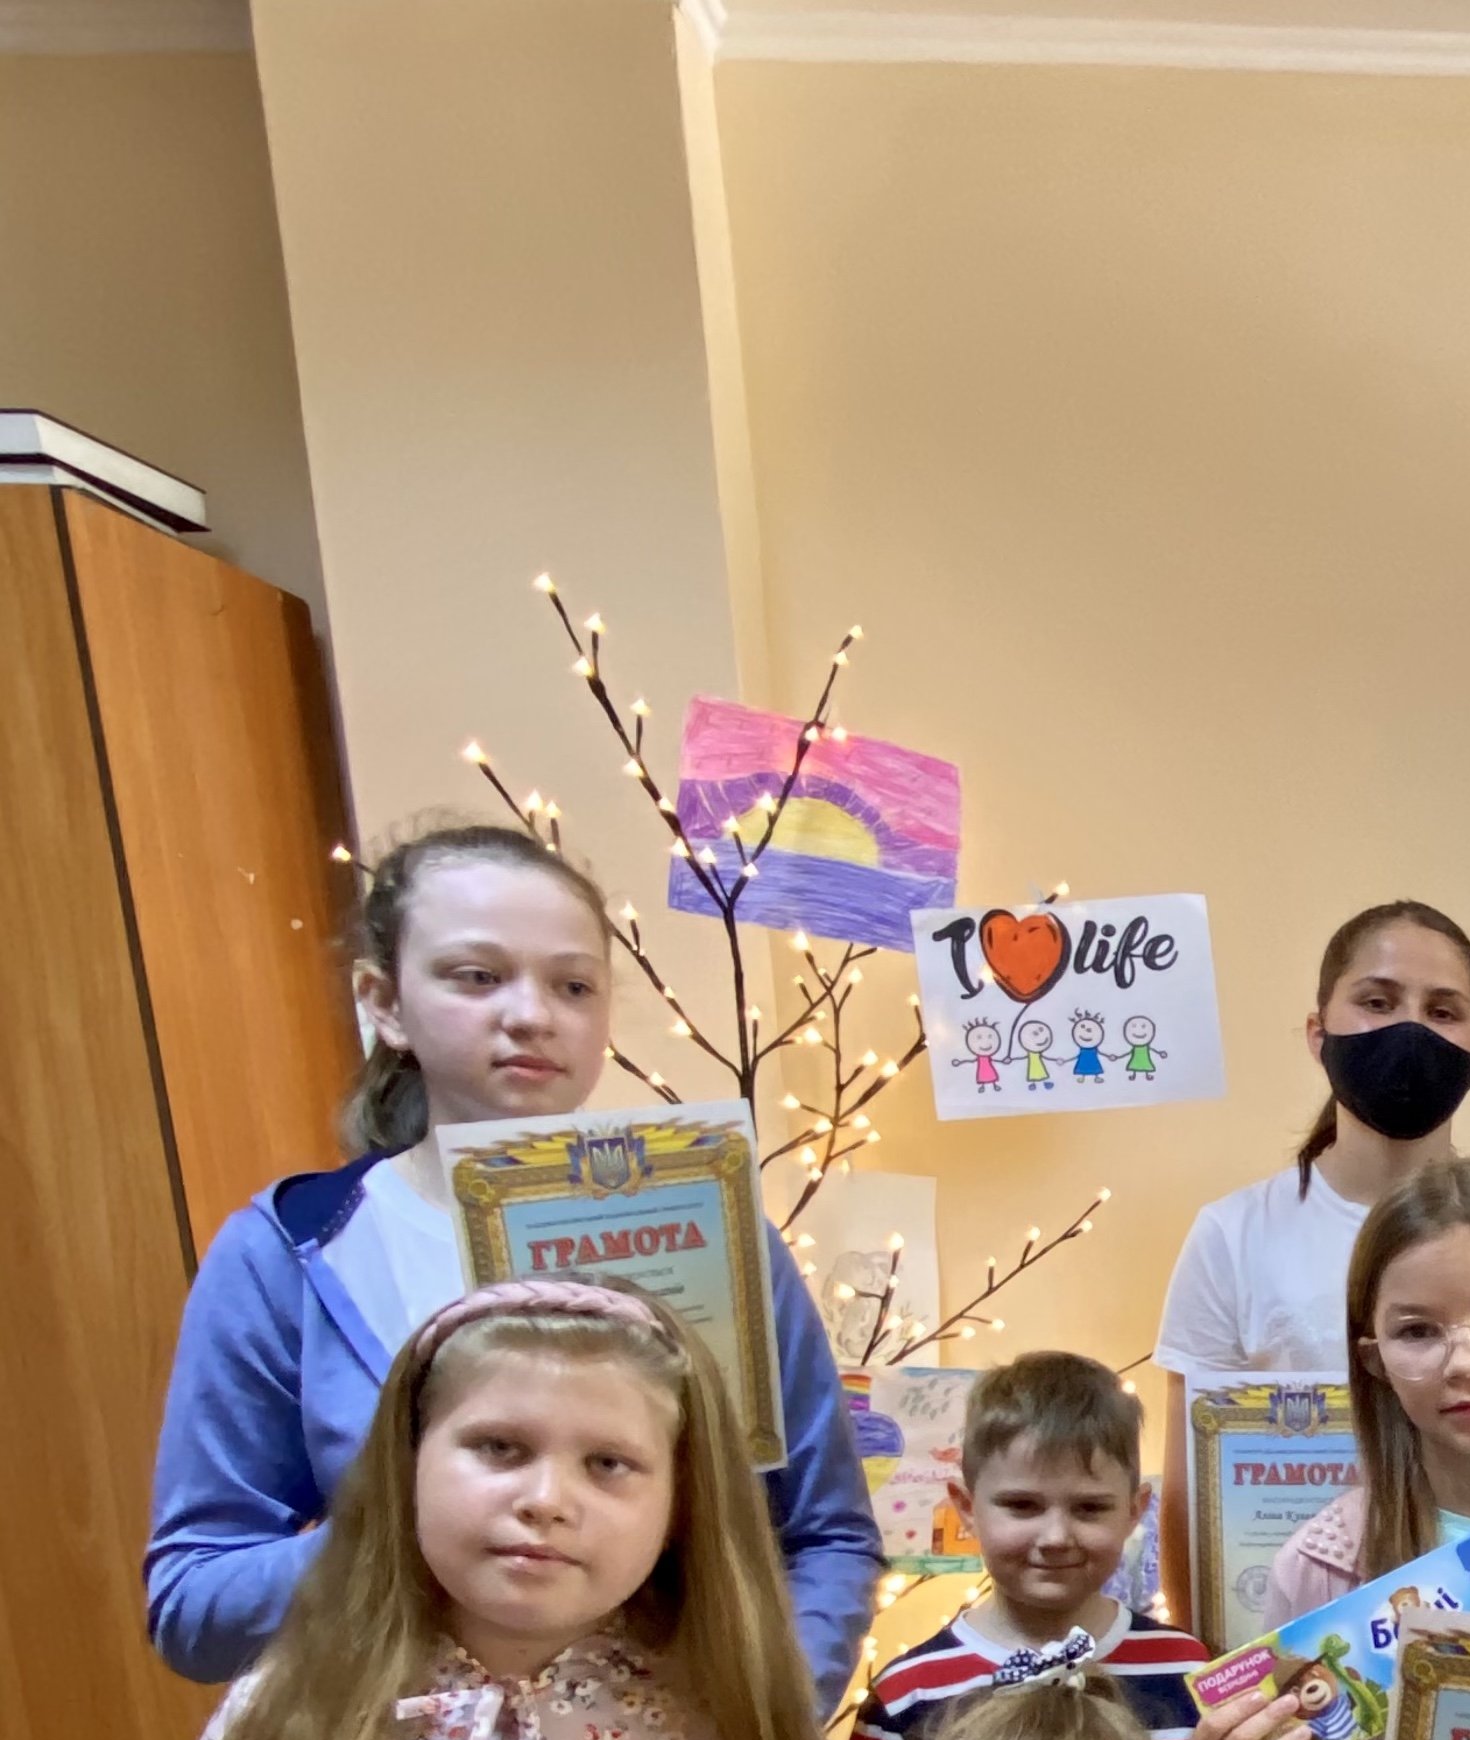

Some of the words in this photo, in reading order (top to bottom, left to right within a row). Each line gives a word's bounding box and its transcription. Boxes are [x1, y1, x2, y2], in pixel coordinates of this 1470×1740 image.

[932, 916, 984, 999] I
[1073, 916, 1178, 989] life
[527, 1220, 708, 1270] ГРАМОТА
[1233, 1462, 1361, 1486] ГРАМОТА
[1198, 1649, 1271, 1692] ПОДАРУНОК
